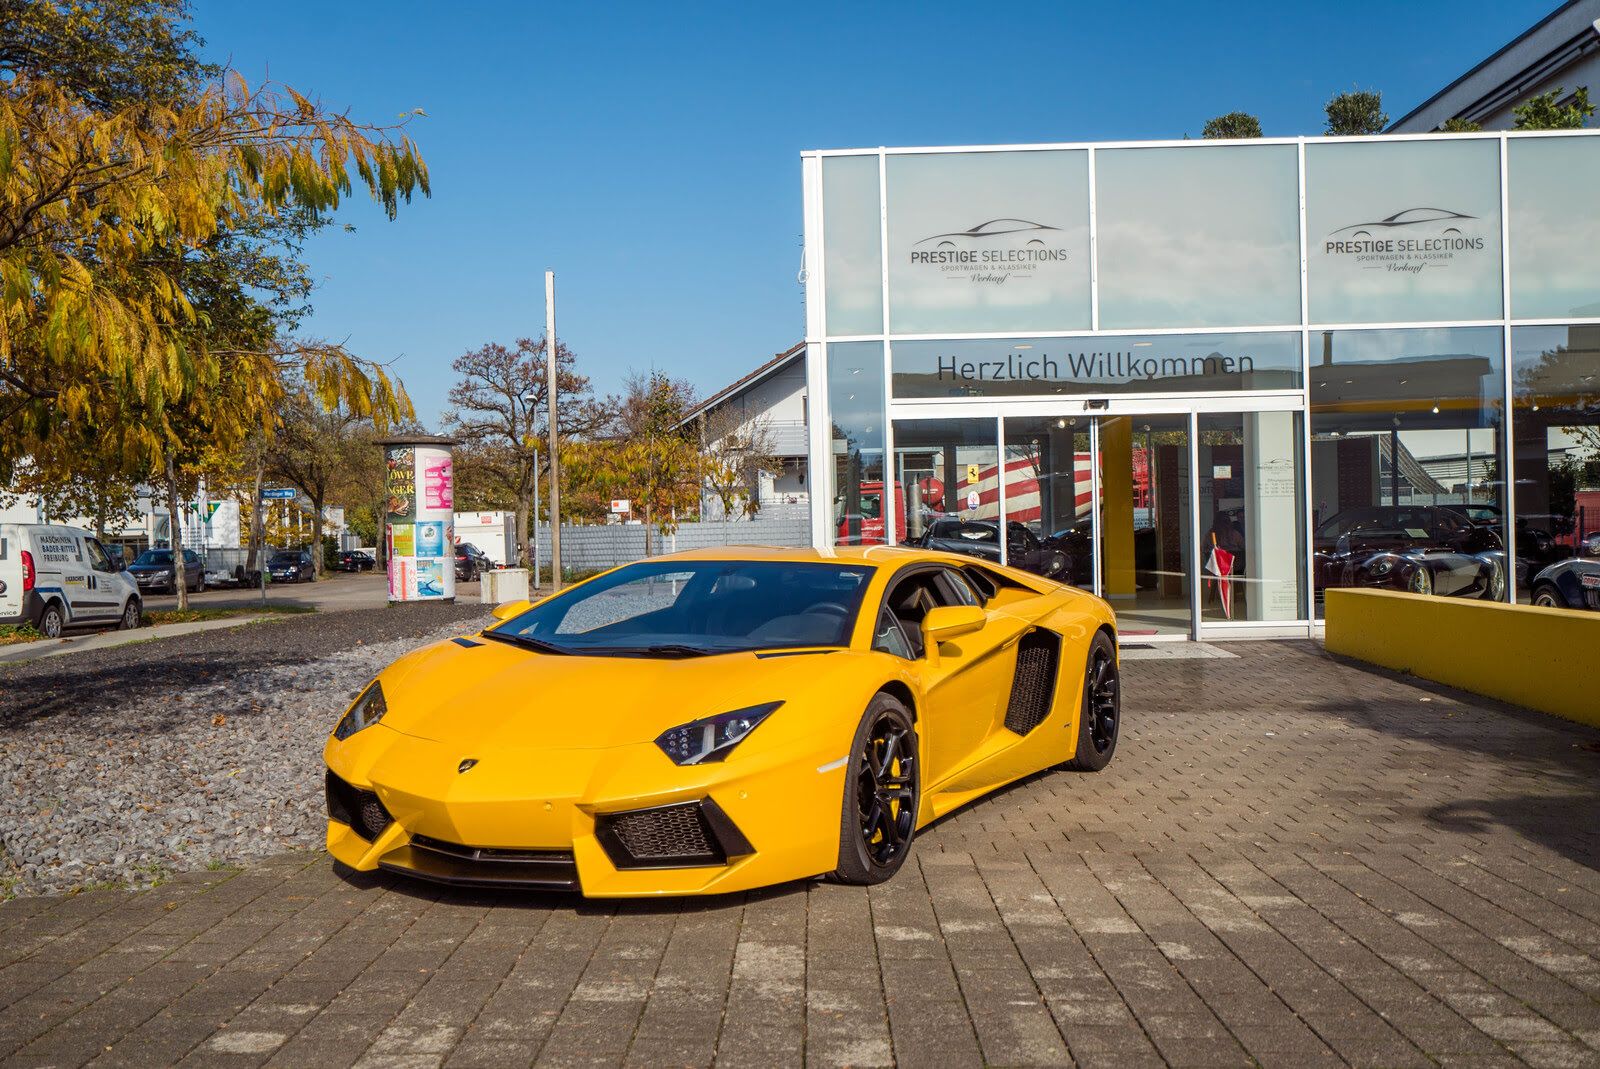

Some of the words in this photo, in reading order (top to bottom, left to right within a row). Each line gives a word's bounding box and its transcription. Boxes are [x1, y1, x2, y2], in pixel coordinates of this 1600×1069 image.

[1326, 240, 1393, 254] PRESTIGE
[1397, 238, 1484, 251] SELECTIONS
[911, 250, 978, 264] PRESTIGE
[982, 249, 1067, 262] SELECTIONS
[1356, 254, 1405, 262] SPORTWAGEN
[941, 264, 988, 272] SPORTWAGEN
[998, 263, 1037, 271] KLASSIKER
[1386, 262, 1427, 274] Verkauf
[970, 273, 1010, 285] Verkauf
[937, 354, 1058, 381] Herzlich
[1068, 351, 1254, 379] Willkommen
[40, 535, 72, 544] MASCHINEN
[43, 554, 70, 562] FREIBURG
